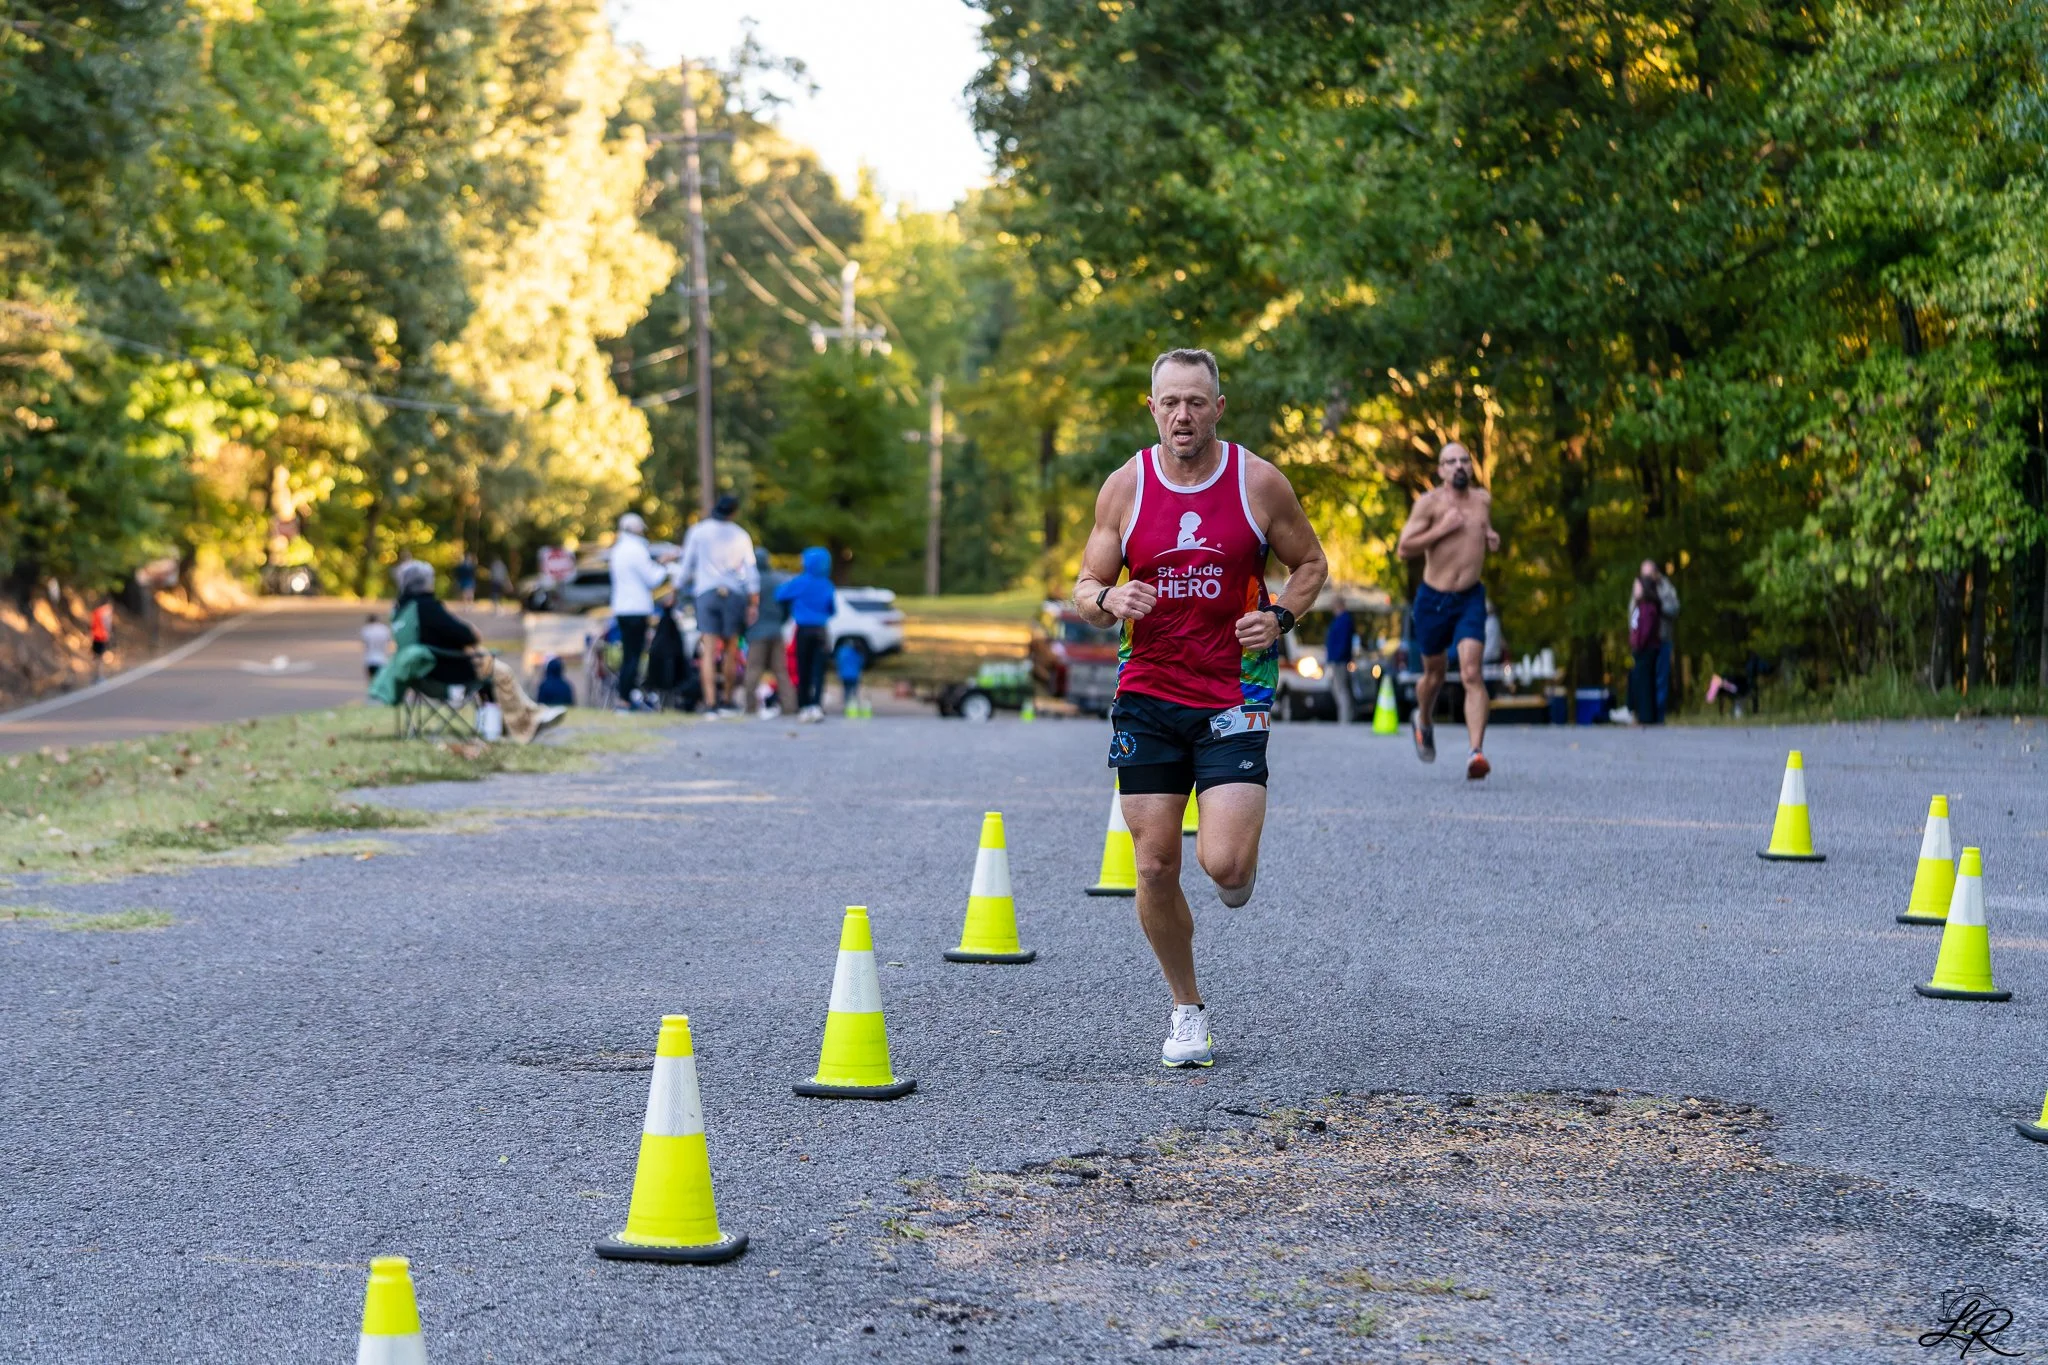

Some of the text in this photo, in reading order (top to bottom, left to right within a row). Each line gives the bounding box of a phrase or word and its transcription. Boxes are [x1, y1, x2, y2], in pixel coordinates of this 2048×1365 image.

[1157, 563, 1223, 578] St. Jude
[1157, 578, 1221, 599] HERO
